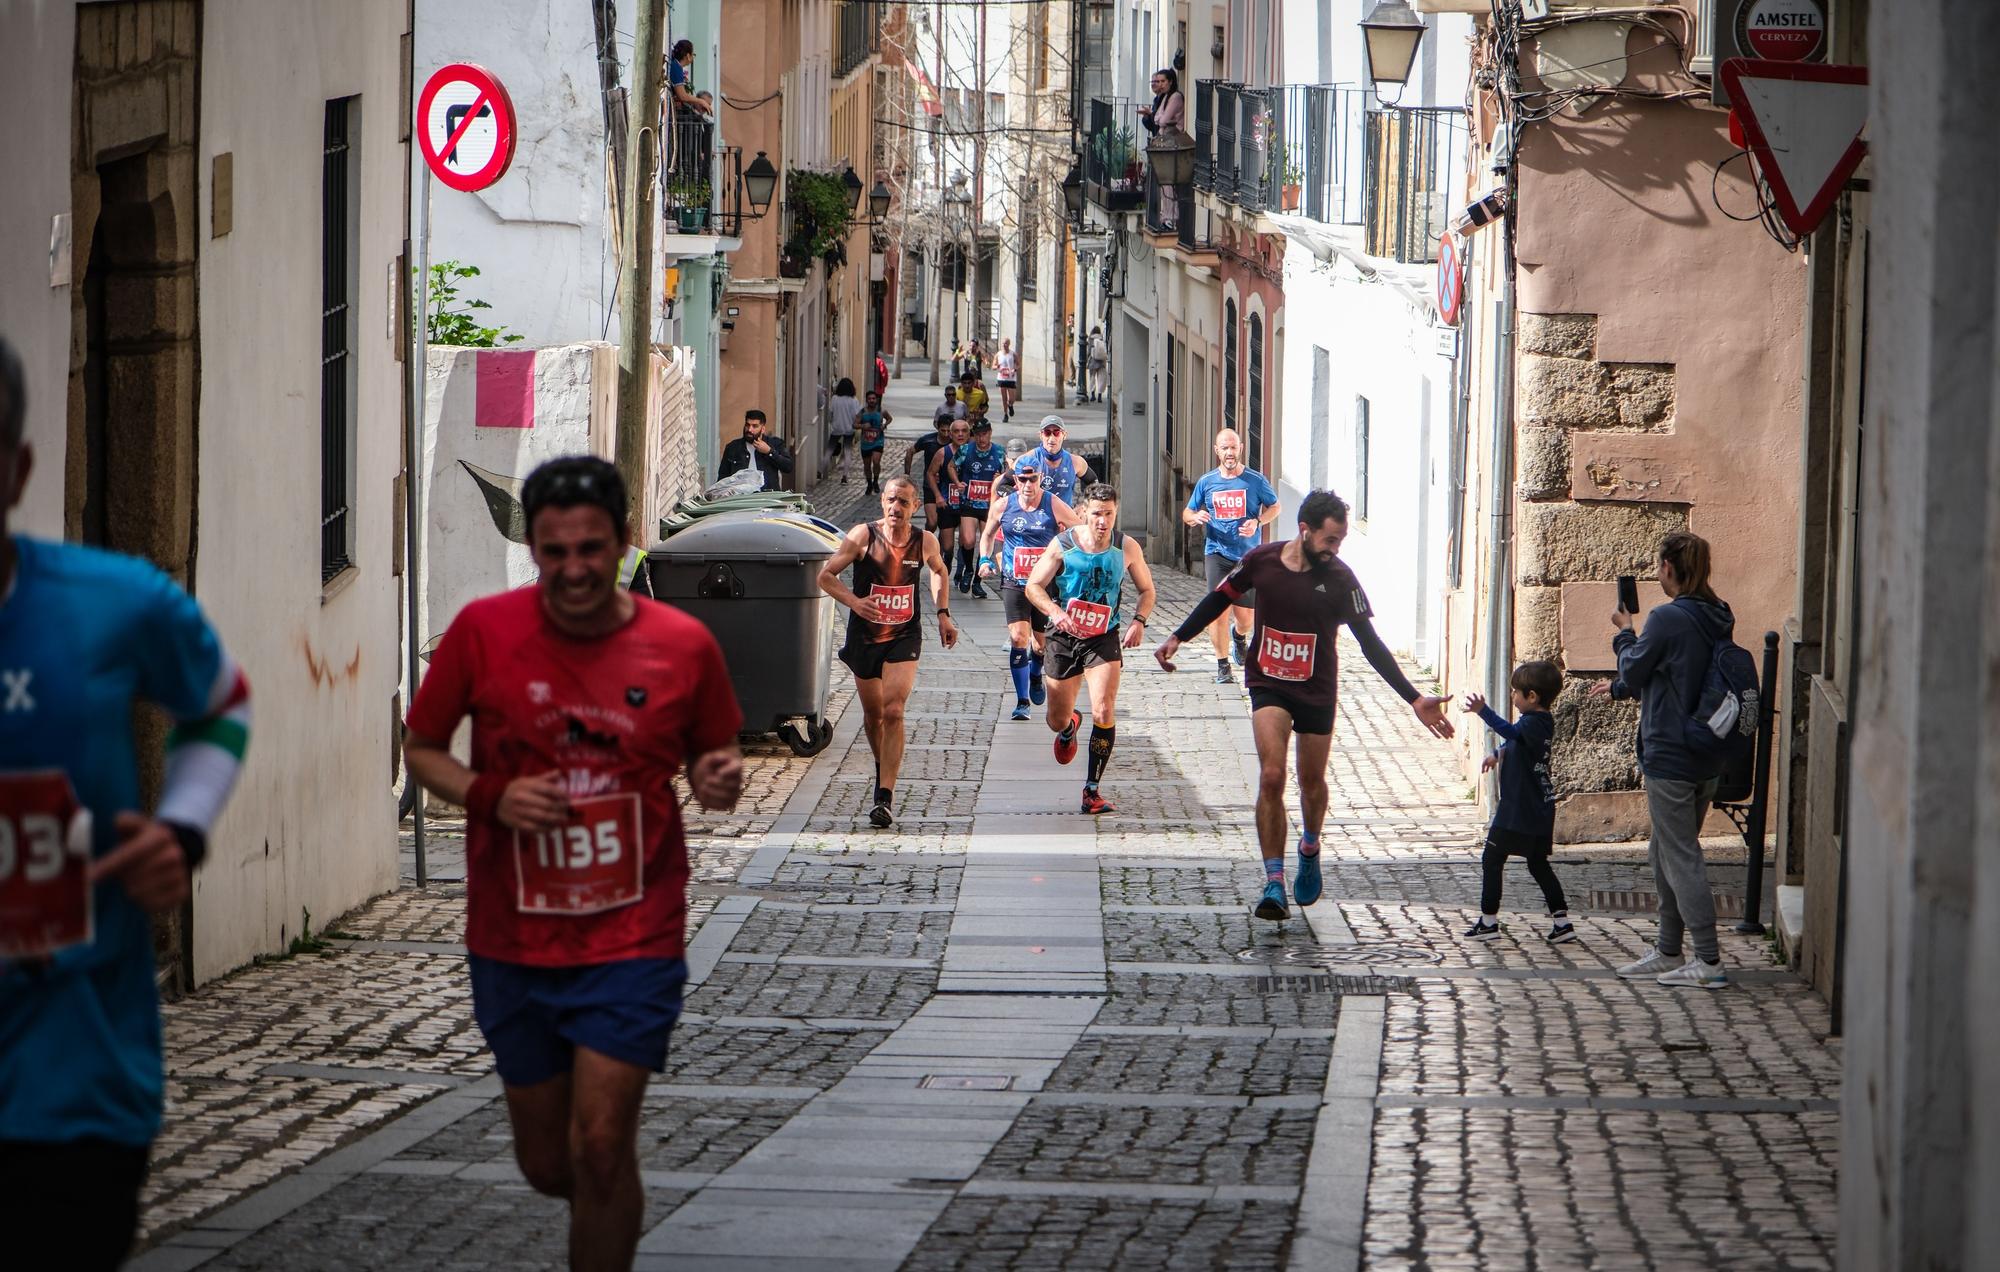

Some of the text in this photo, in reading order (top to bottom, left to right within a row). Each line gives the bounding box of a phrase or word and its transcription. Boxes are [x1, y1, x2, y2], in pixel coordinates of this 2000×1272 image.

[1755, 13, 1816, 26] AMSTEL
[1760, 33, 1809, 42] CERVEZA
[974, 485, 988, 495] 1711
[1215, 496, 1243, 509] 1508
[1019, 554, 1042, 567] 172
[1070, 607, 1106, 629] 1497
[1265, 637, 1309, 662] 1304
[537, 820, 622, 869] 1135
